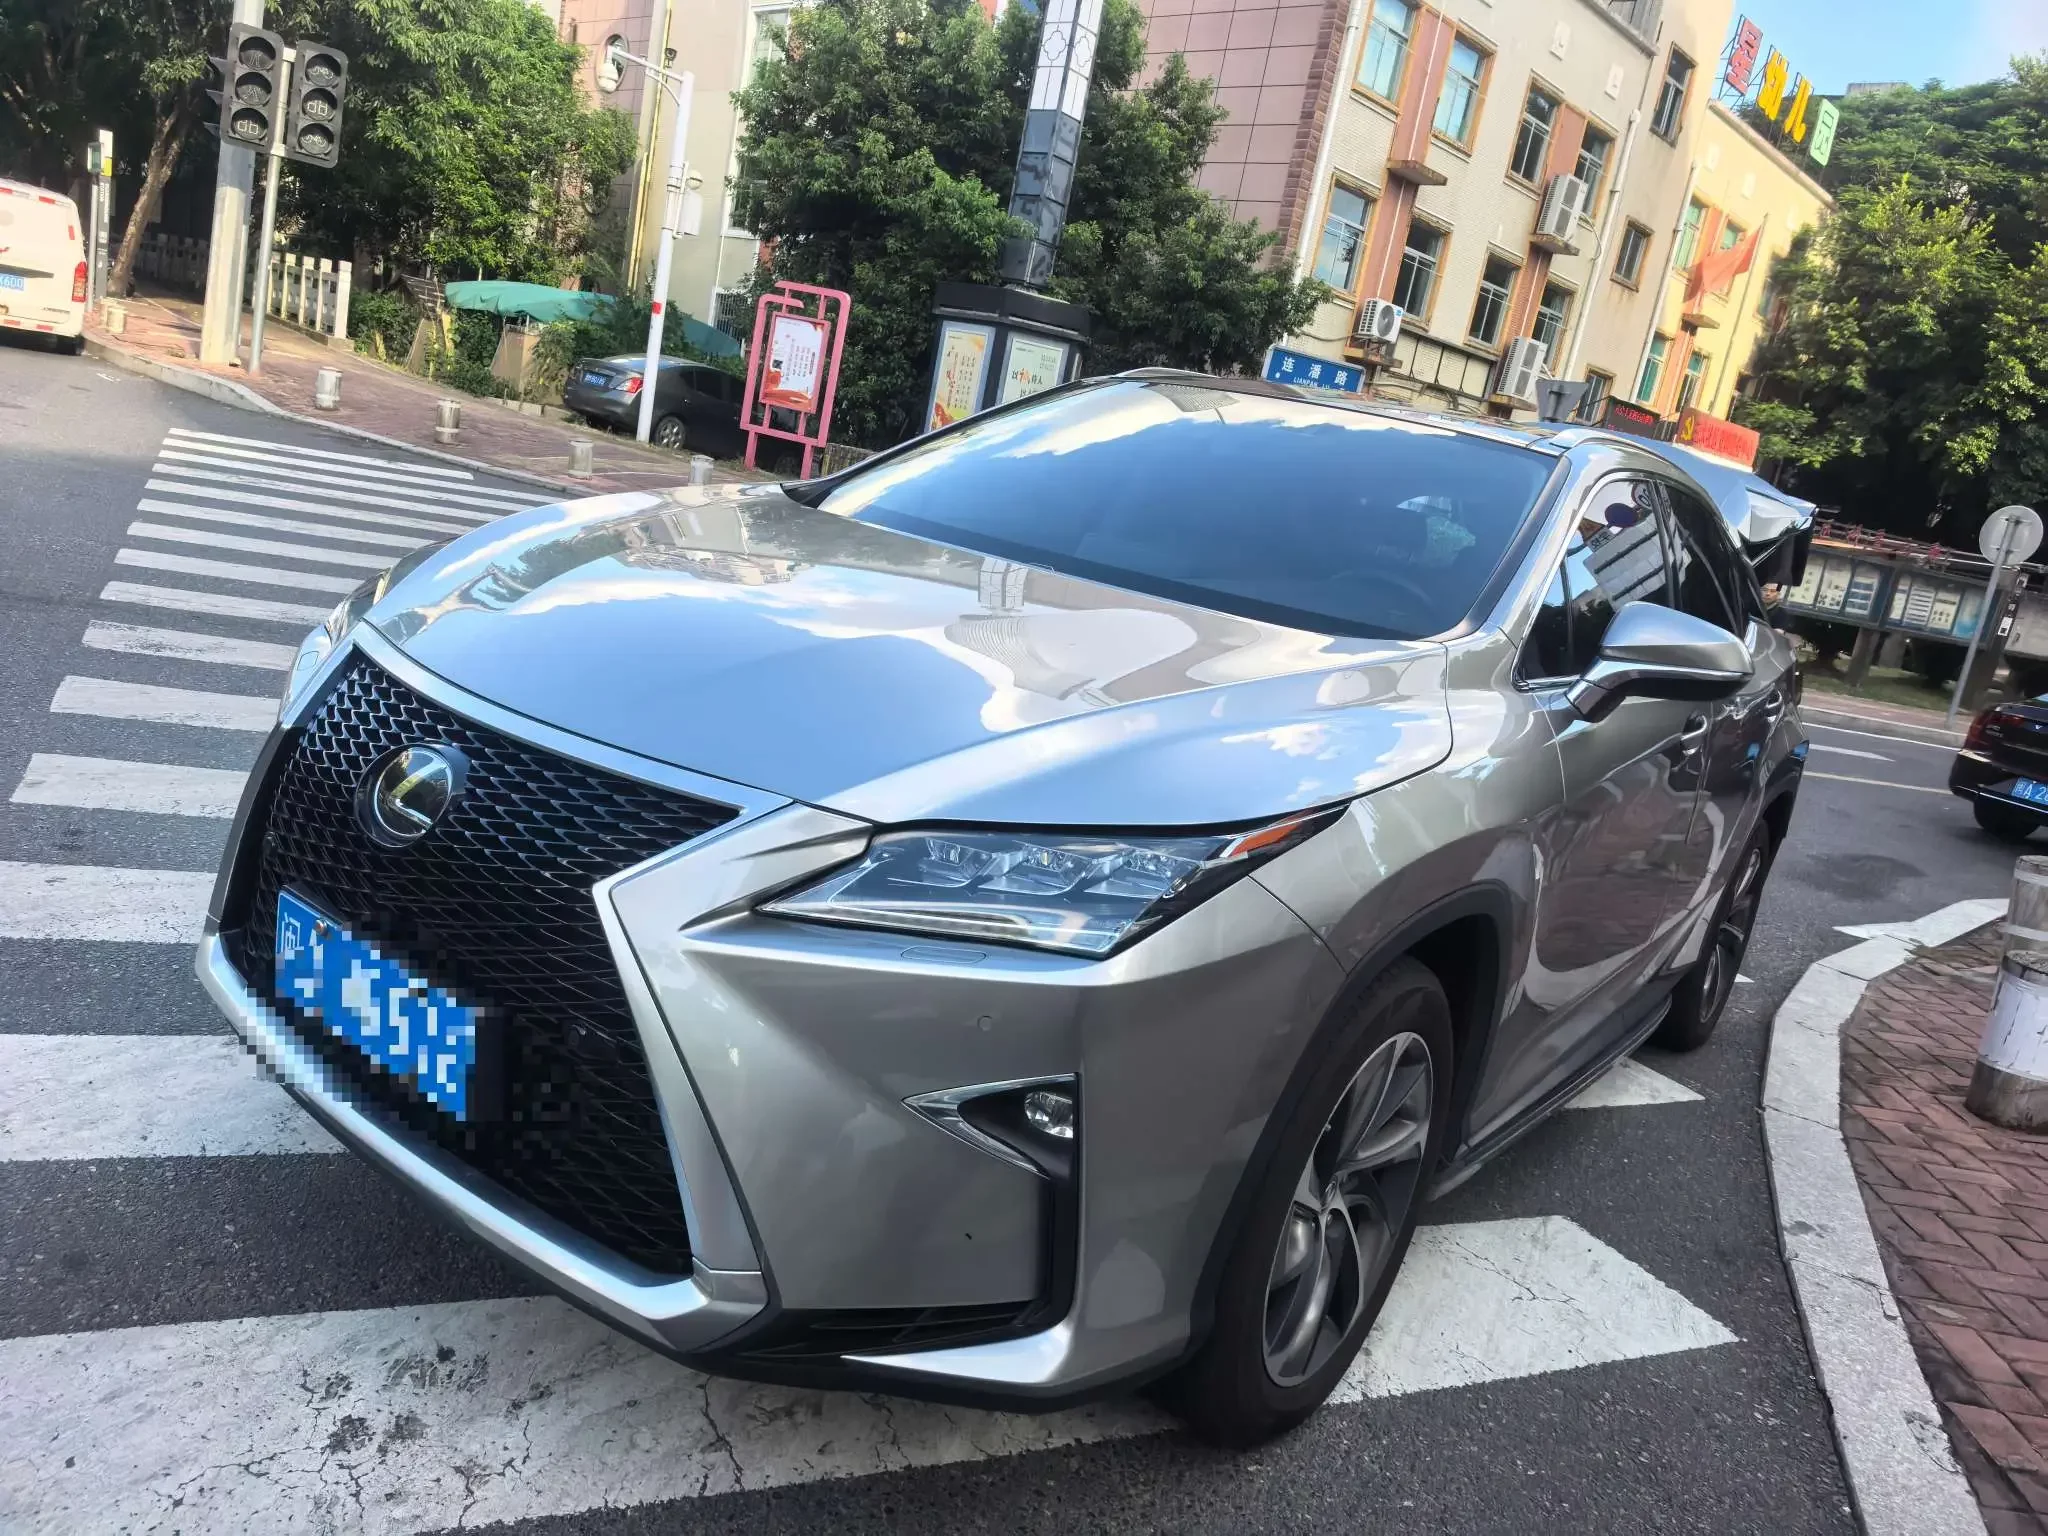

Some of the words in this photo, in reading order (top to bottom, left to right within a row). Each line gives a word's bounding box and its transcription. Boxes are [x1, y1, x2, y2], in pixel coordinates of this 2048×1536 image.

[1281, 356, 1348, 386] 连潘路
[1293, 376, 1318, 388] LIANPAN
